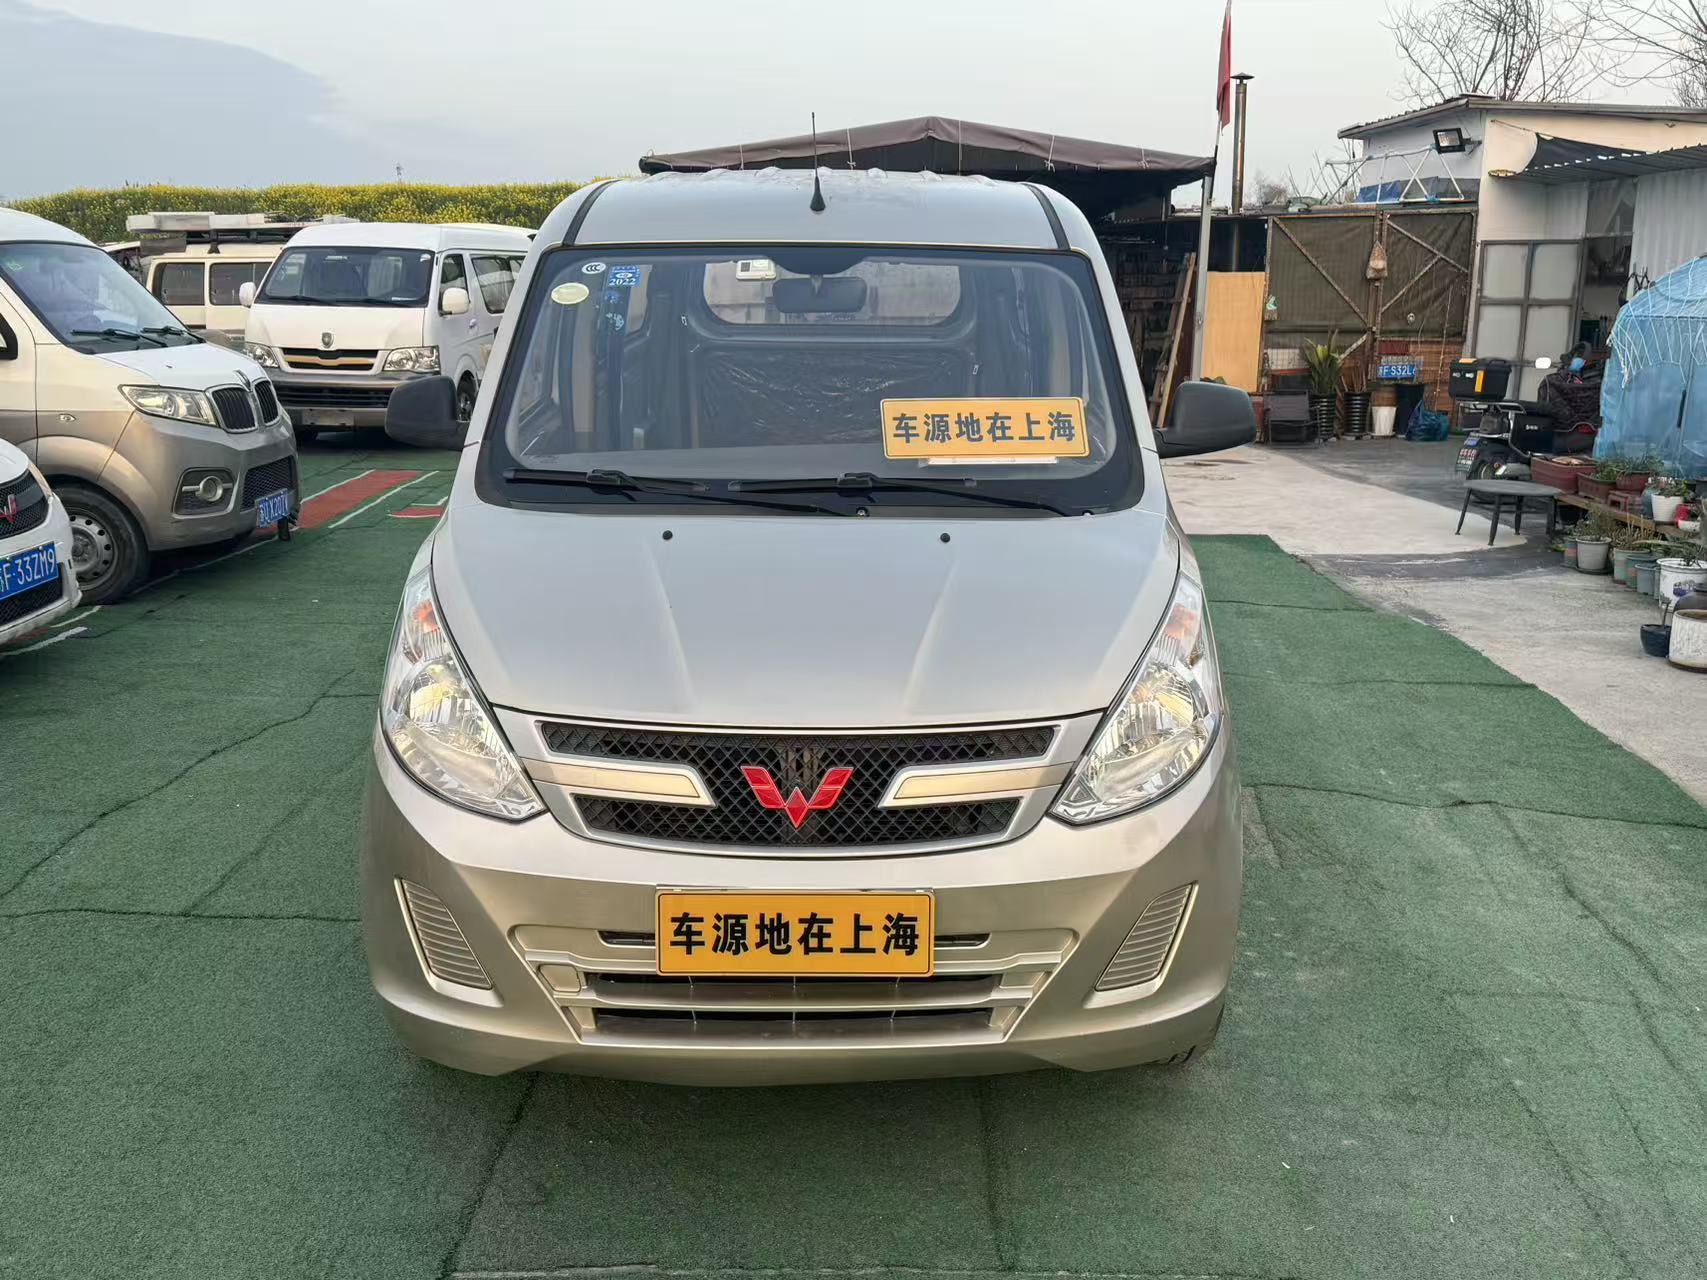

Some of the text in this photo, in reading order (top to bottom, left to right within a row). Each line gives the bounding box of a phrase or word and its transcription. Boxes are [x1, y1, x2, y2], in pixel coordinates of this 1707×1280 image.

[608, 278, 636, 287] 2022
[892, 411, 1076, 444] 车源地在上海
[0, 548, 56, 593] F·33ZM9
[669, 912, 919, 956] 车源地在上海
